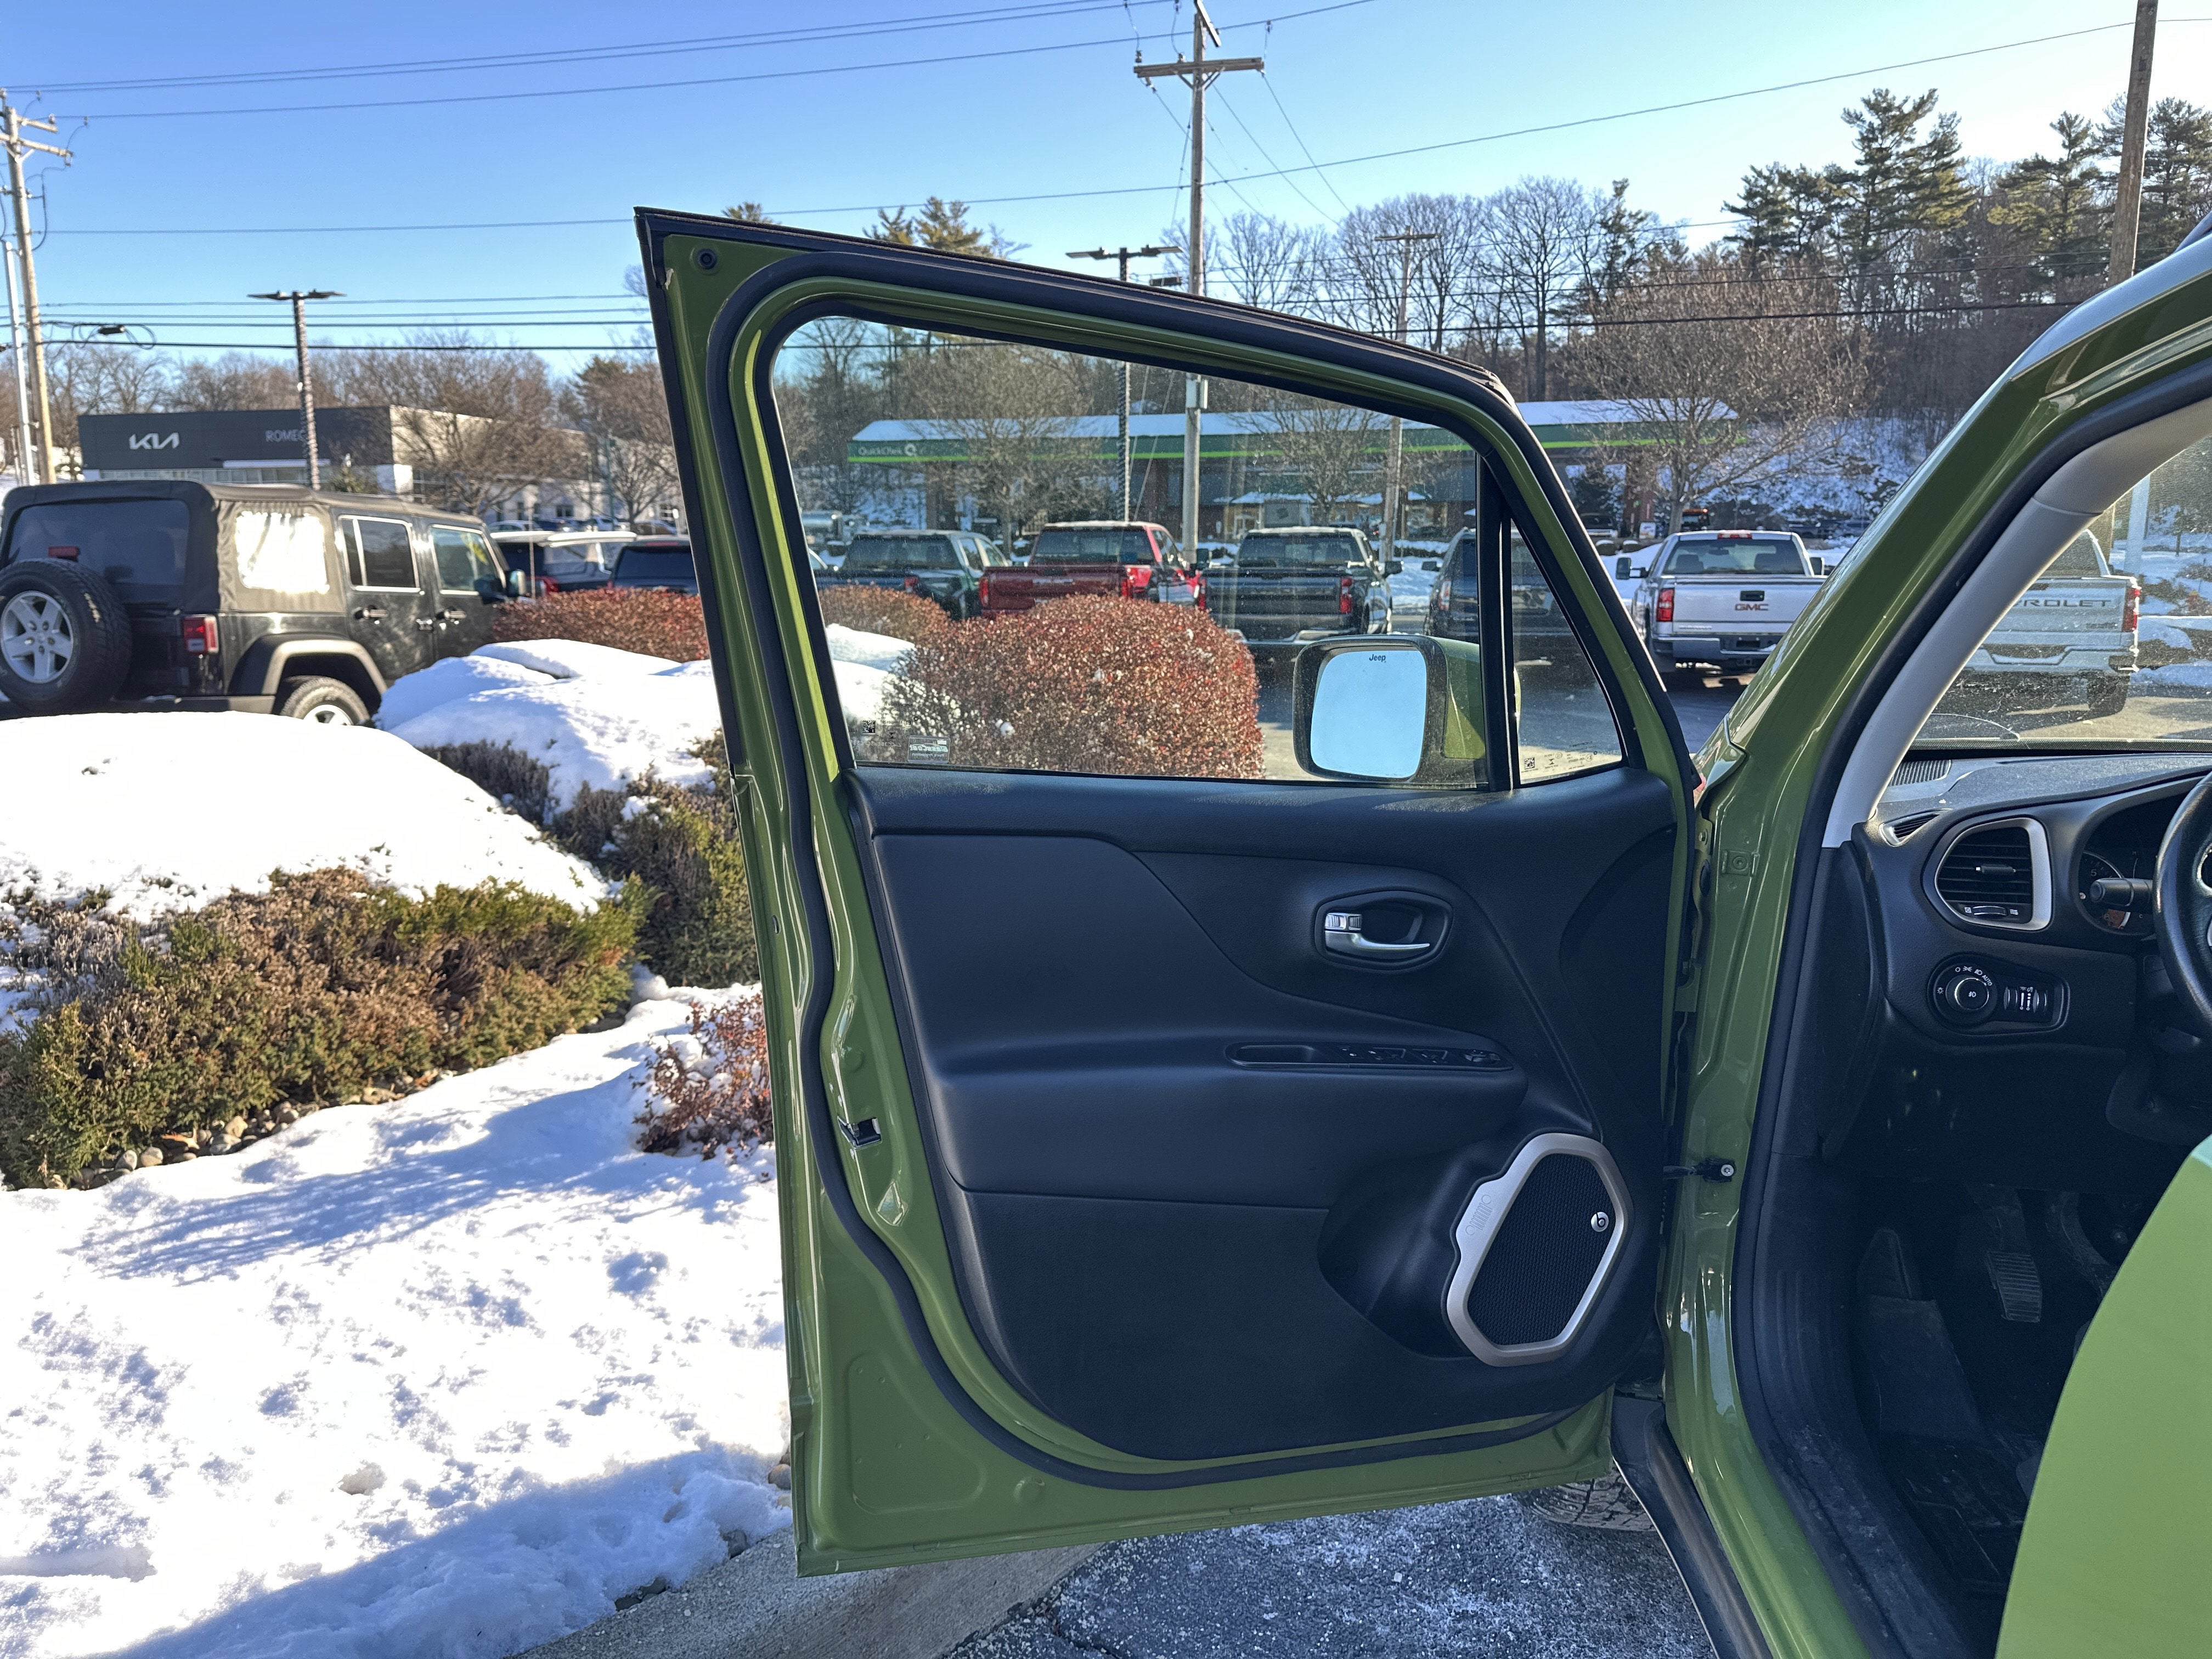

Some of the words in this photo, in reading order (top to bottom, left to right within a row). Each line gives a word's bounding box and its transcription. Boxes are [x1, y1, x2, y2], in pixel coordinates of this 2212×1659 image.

[129, 432, 179, 449] KIA
[1369, 653, 1386, 663] Jeep
[1982, 975, 1993, 986] AUTO
